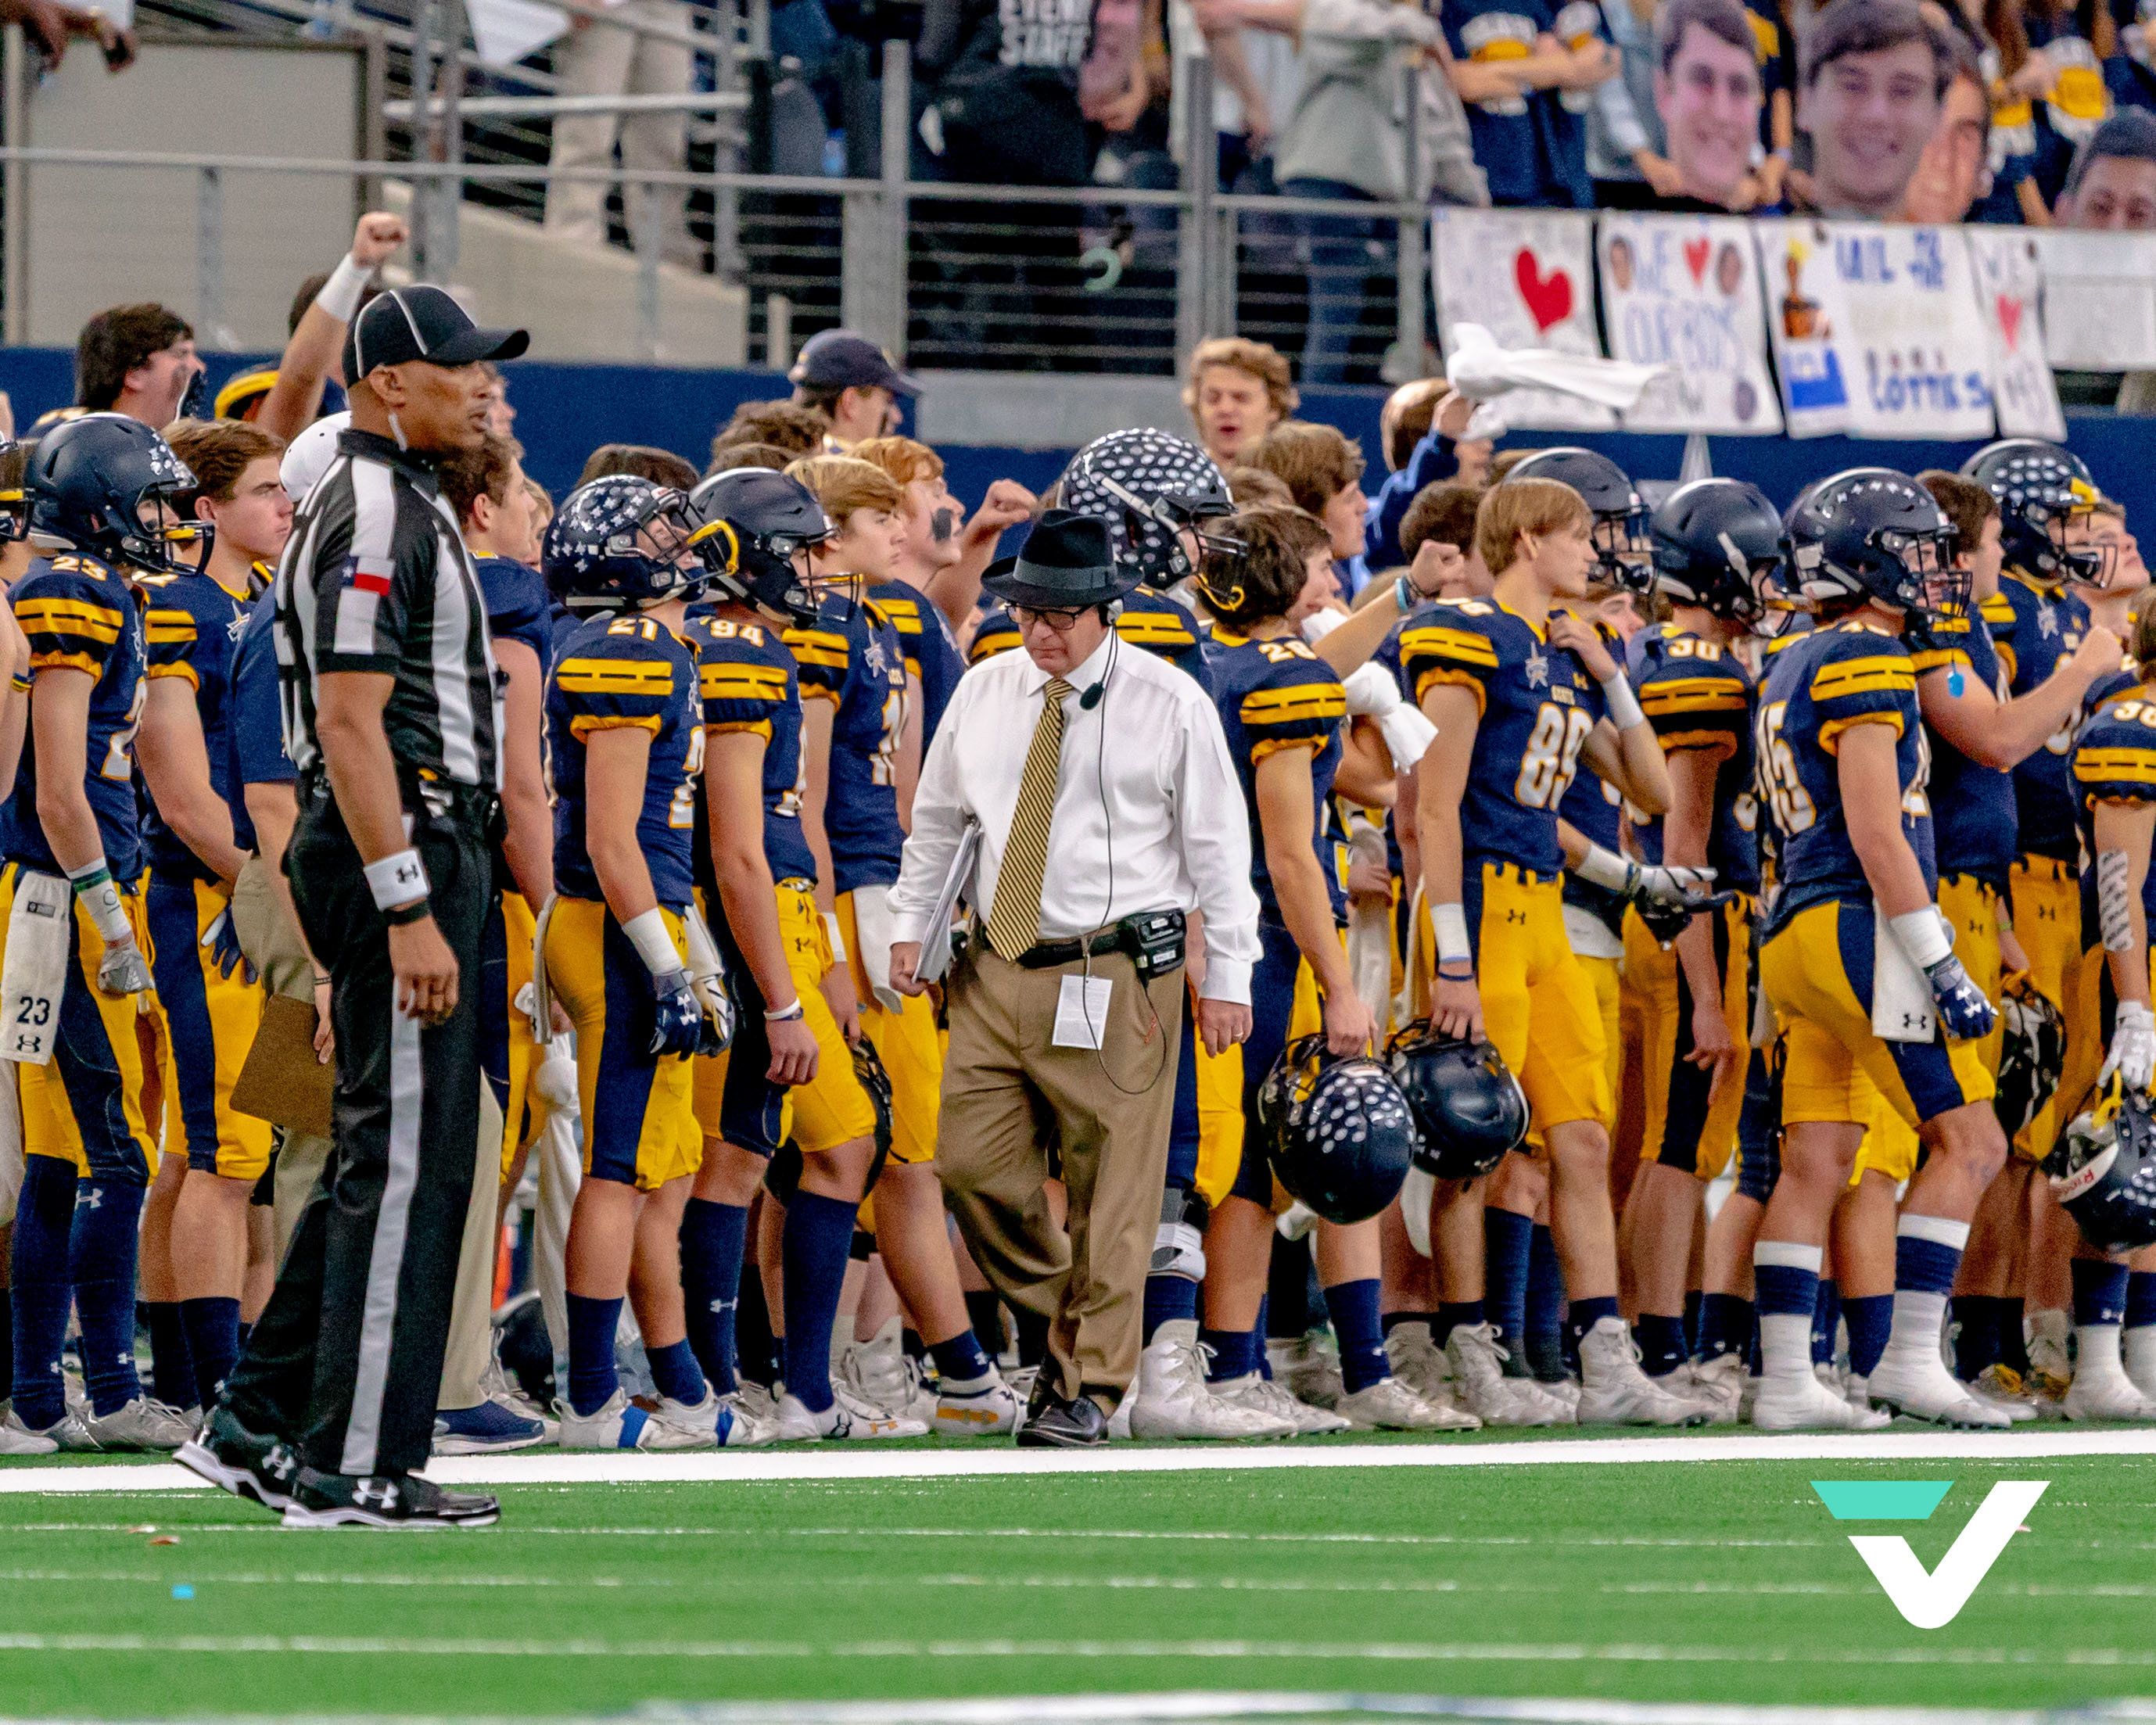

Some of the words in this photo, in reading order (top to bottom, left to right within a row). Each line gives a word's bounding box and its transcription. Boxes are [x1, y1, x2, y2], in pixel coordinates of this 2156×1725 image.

[51, 555, 108, 582] 23
[607, 616, 658, 642] 21
[709, 619, 765, 648] 94
[16, 995, 51, 1026] 23
